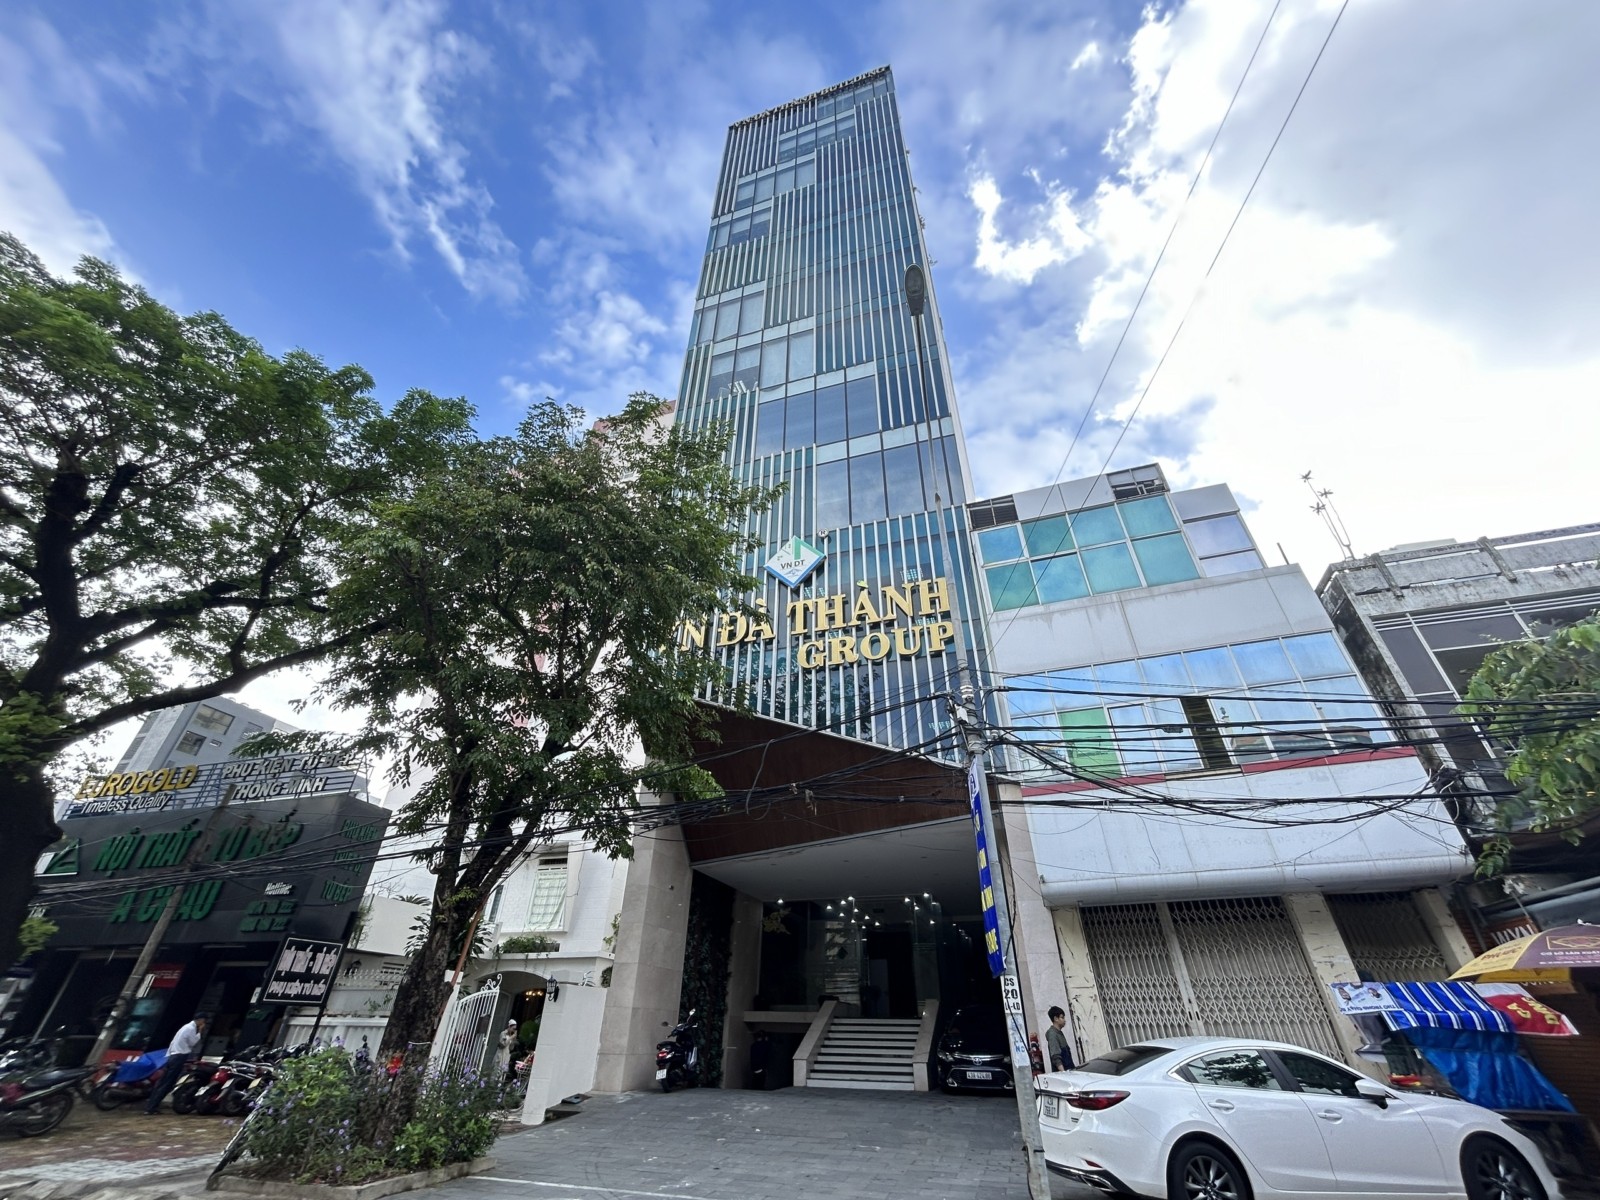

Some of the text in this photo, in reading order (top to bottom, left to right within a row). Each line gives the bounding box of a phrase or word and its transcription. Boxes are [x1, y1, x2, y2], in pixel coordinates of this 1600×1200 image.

[786, 577, 951, 635] THÀNH
[797, 621, 954, 670] GROUP
[75, 764, 199, 800] EUROGOLD
[287, 777, 327, 795] MINH
[81, 793, 170, 814] Timeless Quality
[1004, 978, 1014, 987] CS
[1004, 988, 1018, 1000] 20
